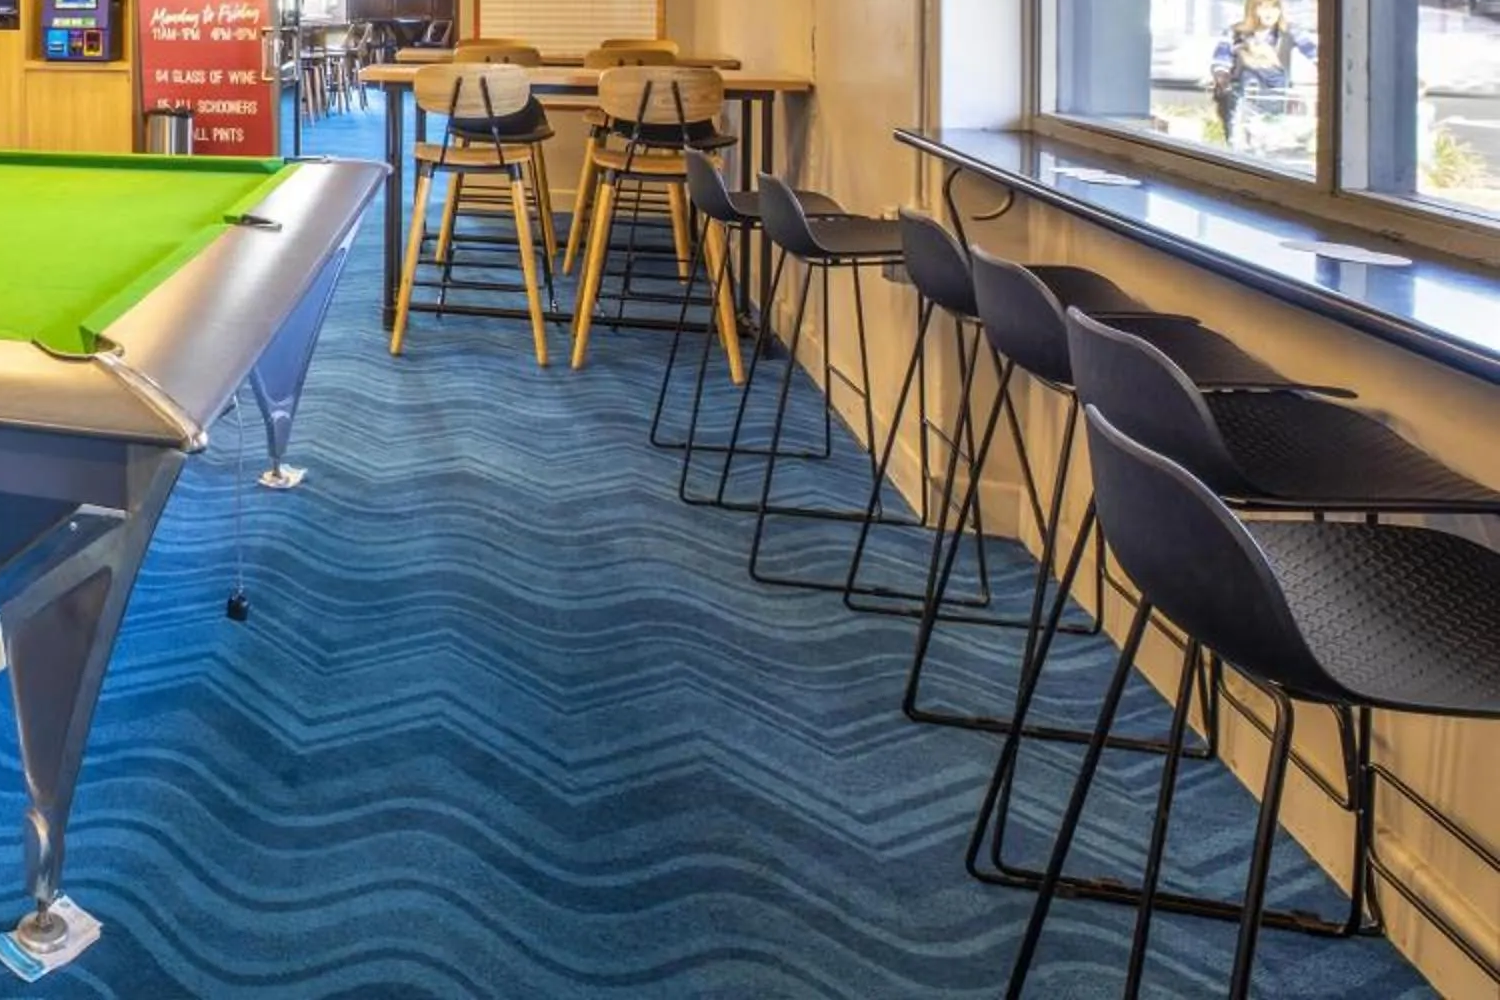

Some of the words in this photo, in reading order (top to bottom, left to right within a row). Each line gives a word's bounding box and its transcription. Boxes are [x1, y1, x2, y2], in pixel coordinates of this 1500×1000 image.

[149, 7, 200, 28] Monday
[202, 3, 215, 24] to
[218, 2, 260, 24] Friday
[172, 69, 206, 85] GLASS
[209, 70, 223, 84] OF
[228, 70, 257, 85] WINE
[197, 99, 258, 115] SCHOONERS
[213, 127, 244, 143] PINTS
